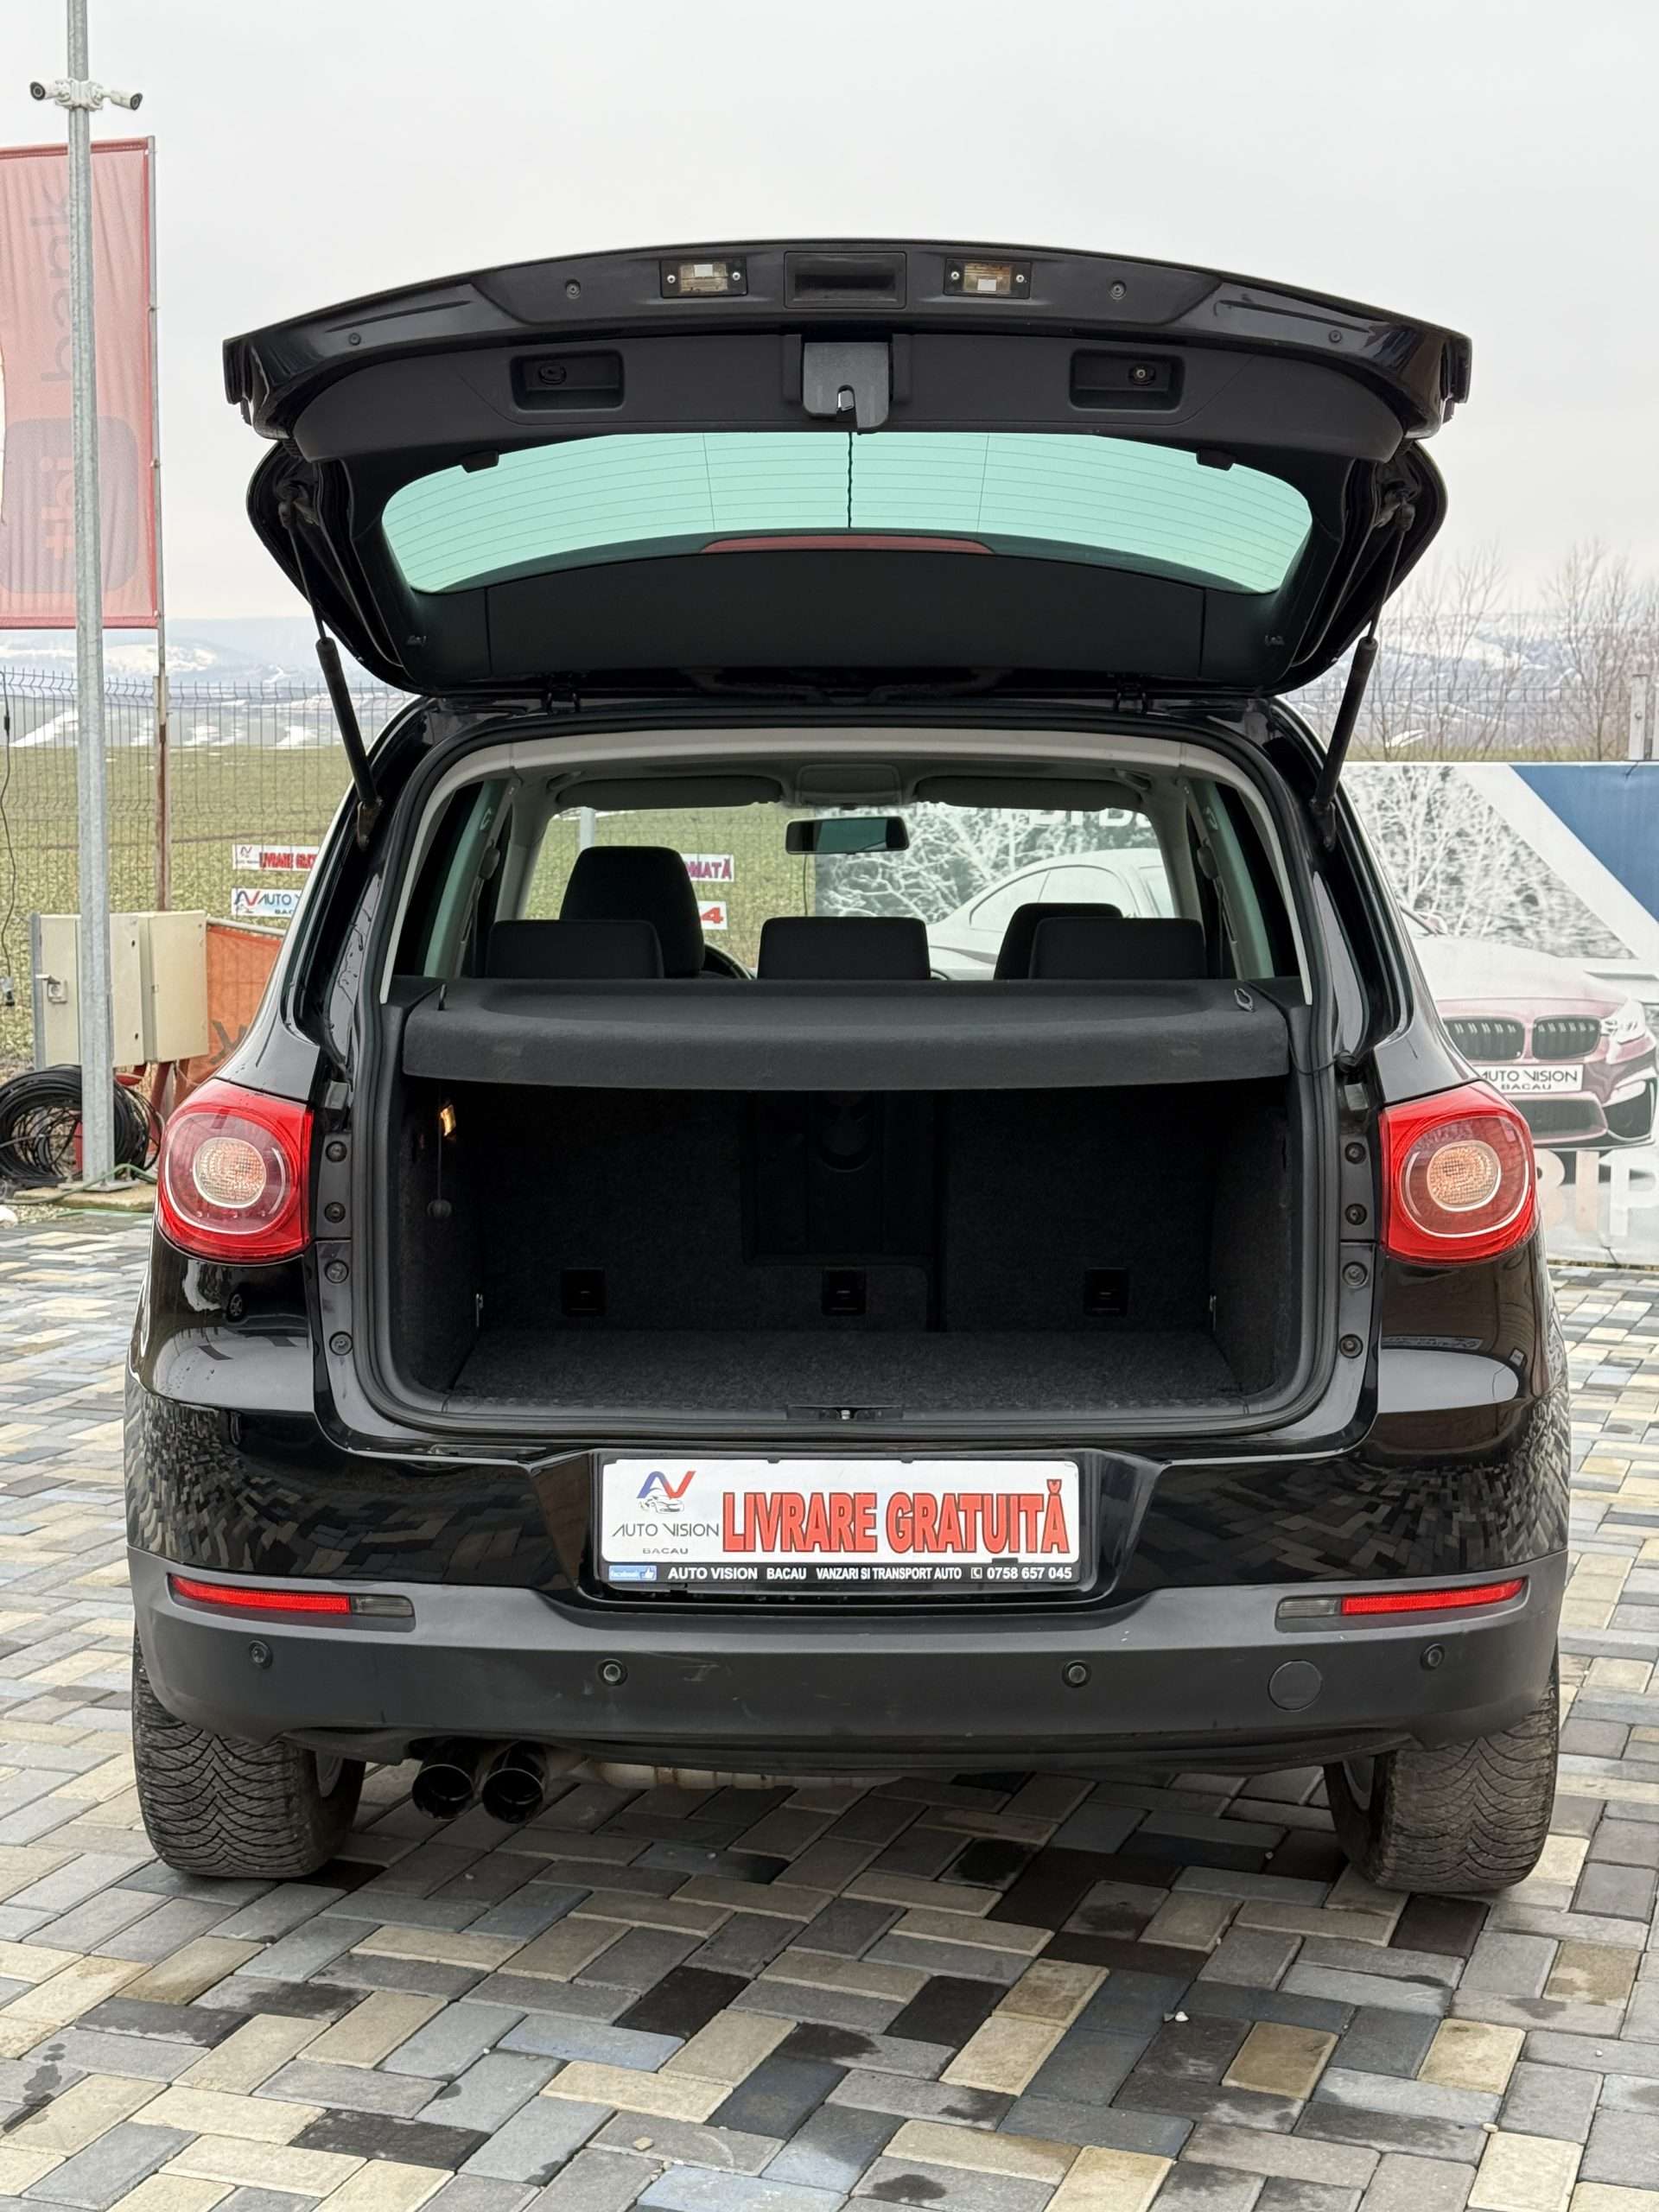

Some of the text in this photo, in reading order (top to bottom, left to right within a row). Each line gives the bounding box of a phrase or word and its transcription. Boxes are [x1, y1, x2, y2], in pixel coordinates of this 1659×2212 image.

[257, 893, 292, 906] AUTO
[1523, 1070, 1578, 1082] VISION
[722, 1478, 1071, 1554] LIVRARE GRATUITĂ
[612, 1523, 720, 1537] AUTO VISION
[667, 1567, 1072, 1580] AUTO VISION BACAU VANZARI SI TRANSPORT AUTO 0758 657 045
